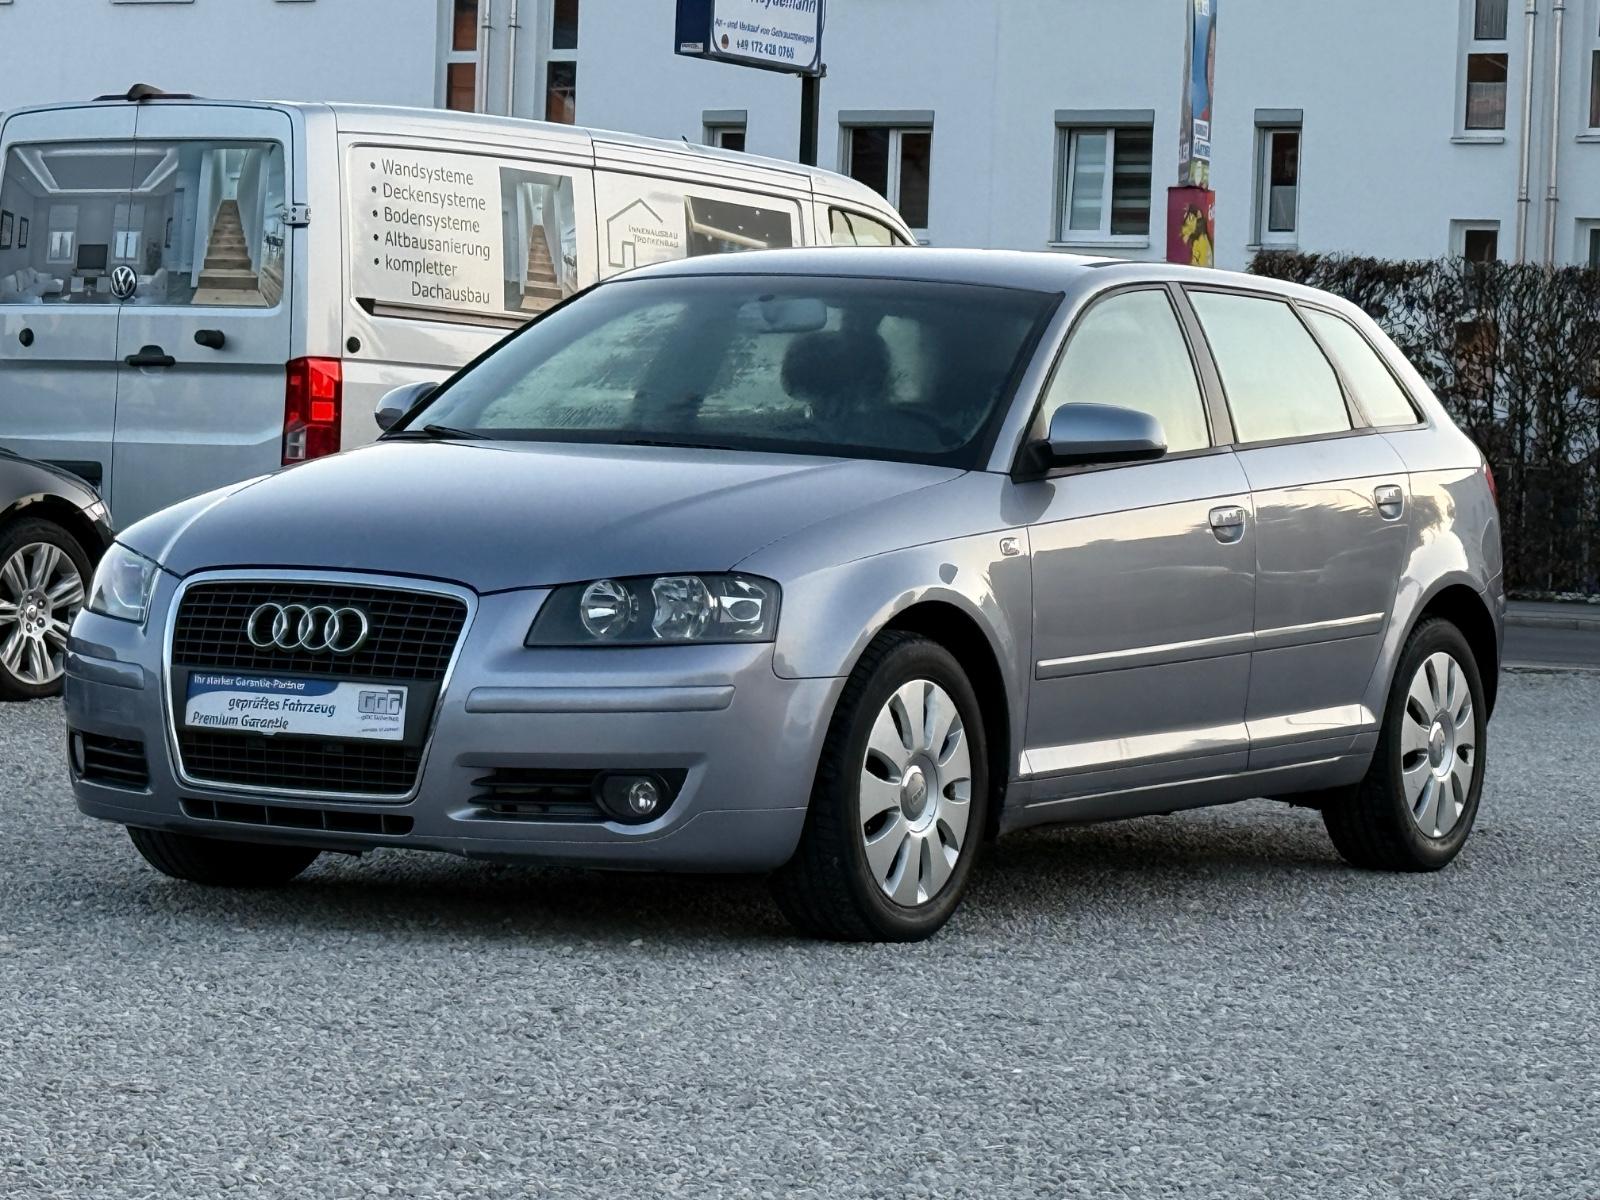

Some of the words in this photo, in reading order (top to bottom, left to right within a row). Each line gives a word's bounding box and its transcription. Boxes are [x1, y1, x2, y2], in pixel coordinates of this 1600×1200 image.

[727, 20, 738, 30] und
[739, 21, 760, 33] Verkauf
[760, 28, 771, 36] von
[736, 39, 749, 51] +49
[751, 40, 763, 54] 172
[381, 158, 474, 186] Wandsysteme
[383, 182, 486, 211] Deckensysteme
[384, 206, 480, 234] Bodensysteme
[384, 231, 490, 261] Altbausanierung
[385, 255, 458, 277] kompletter
[411, 280, 490, 305] Dachausbau
[194, 673, 205, 684] Ihr
[228, 696, 280, 712] geprüftes
[281, 698, 337, 718] Fahrzeug
[192, 711, 239, 726] Premium
[240, 714, 290, 730] Garantie
